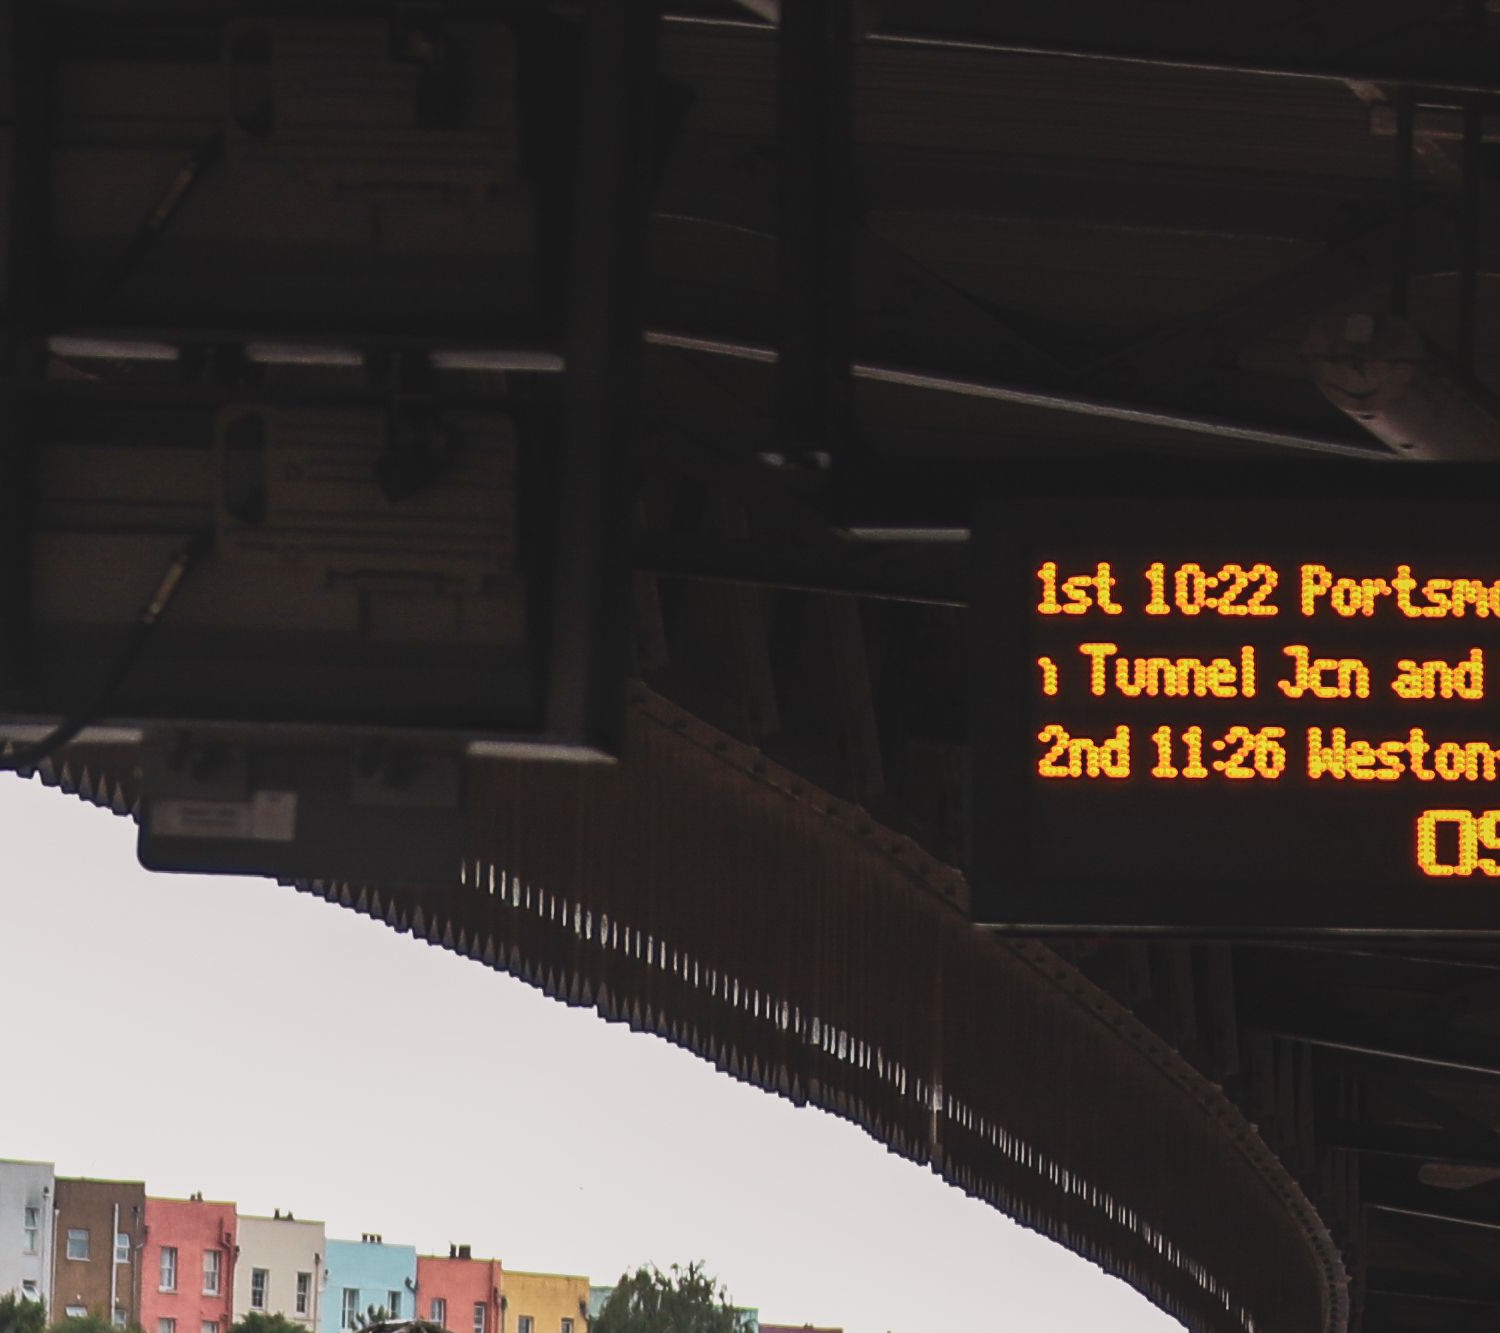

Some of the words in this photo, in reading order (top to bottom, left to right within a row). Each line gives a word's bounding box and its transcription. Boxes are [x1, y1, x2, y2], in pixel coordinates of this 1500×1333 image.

[1036, 561, 1123, 615] 1st
[1144, 561, 1279, 617] 10:22
[1078, 642, 1257, 699] Tunnel
[1277, 644, 1371, 699] Jcn
[1390, 647, 1485, 701] and
[1037, 724, 1131, 779] 2nd
[1150, 725, 1287, 780] 11:26
